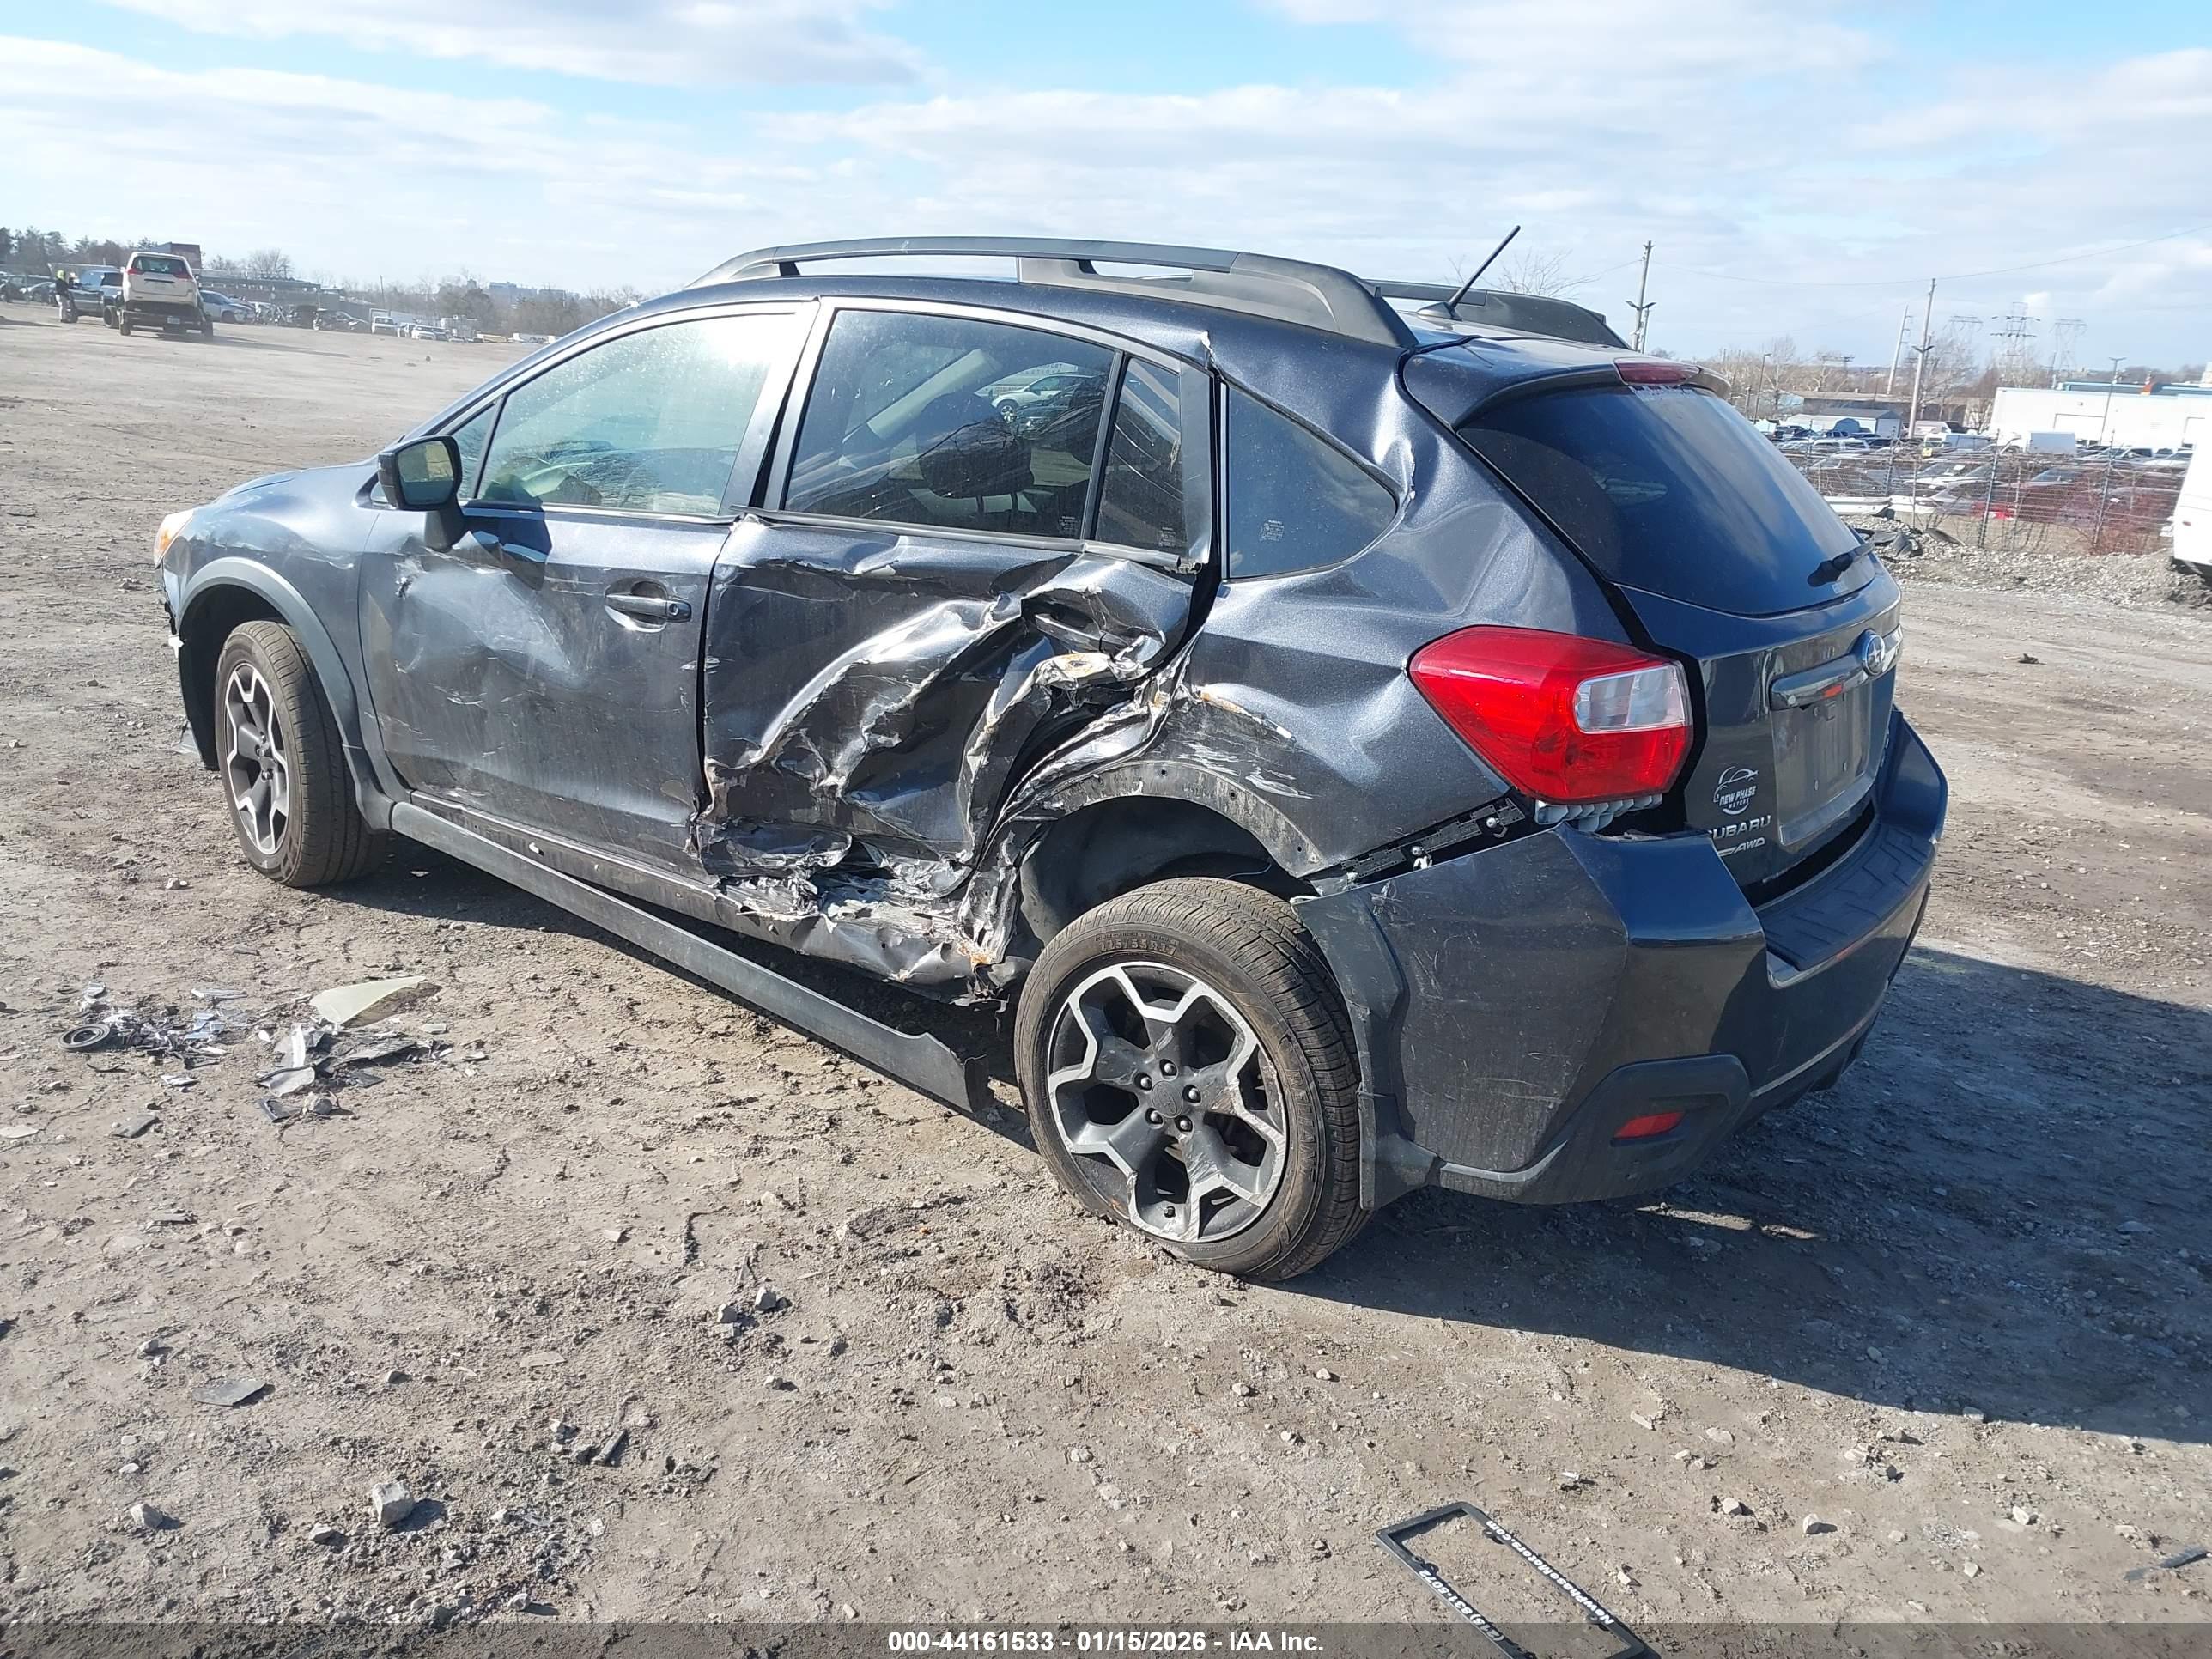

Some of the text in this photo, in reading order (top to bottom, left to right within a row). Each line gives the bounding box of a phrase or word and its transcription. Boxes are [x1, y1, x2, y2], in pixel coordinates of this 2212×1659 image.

[1719, 786, 1756, 806] NEW PHASE
[1734, 837, 1765, 854] AWD
[1486, 1520, 1614, 1625] NewPhaseMotors.com
